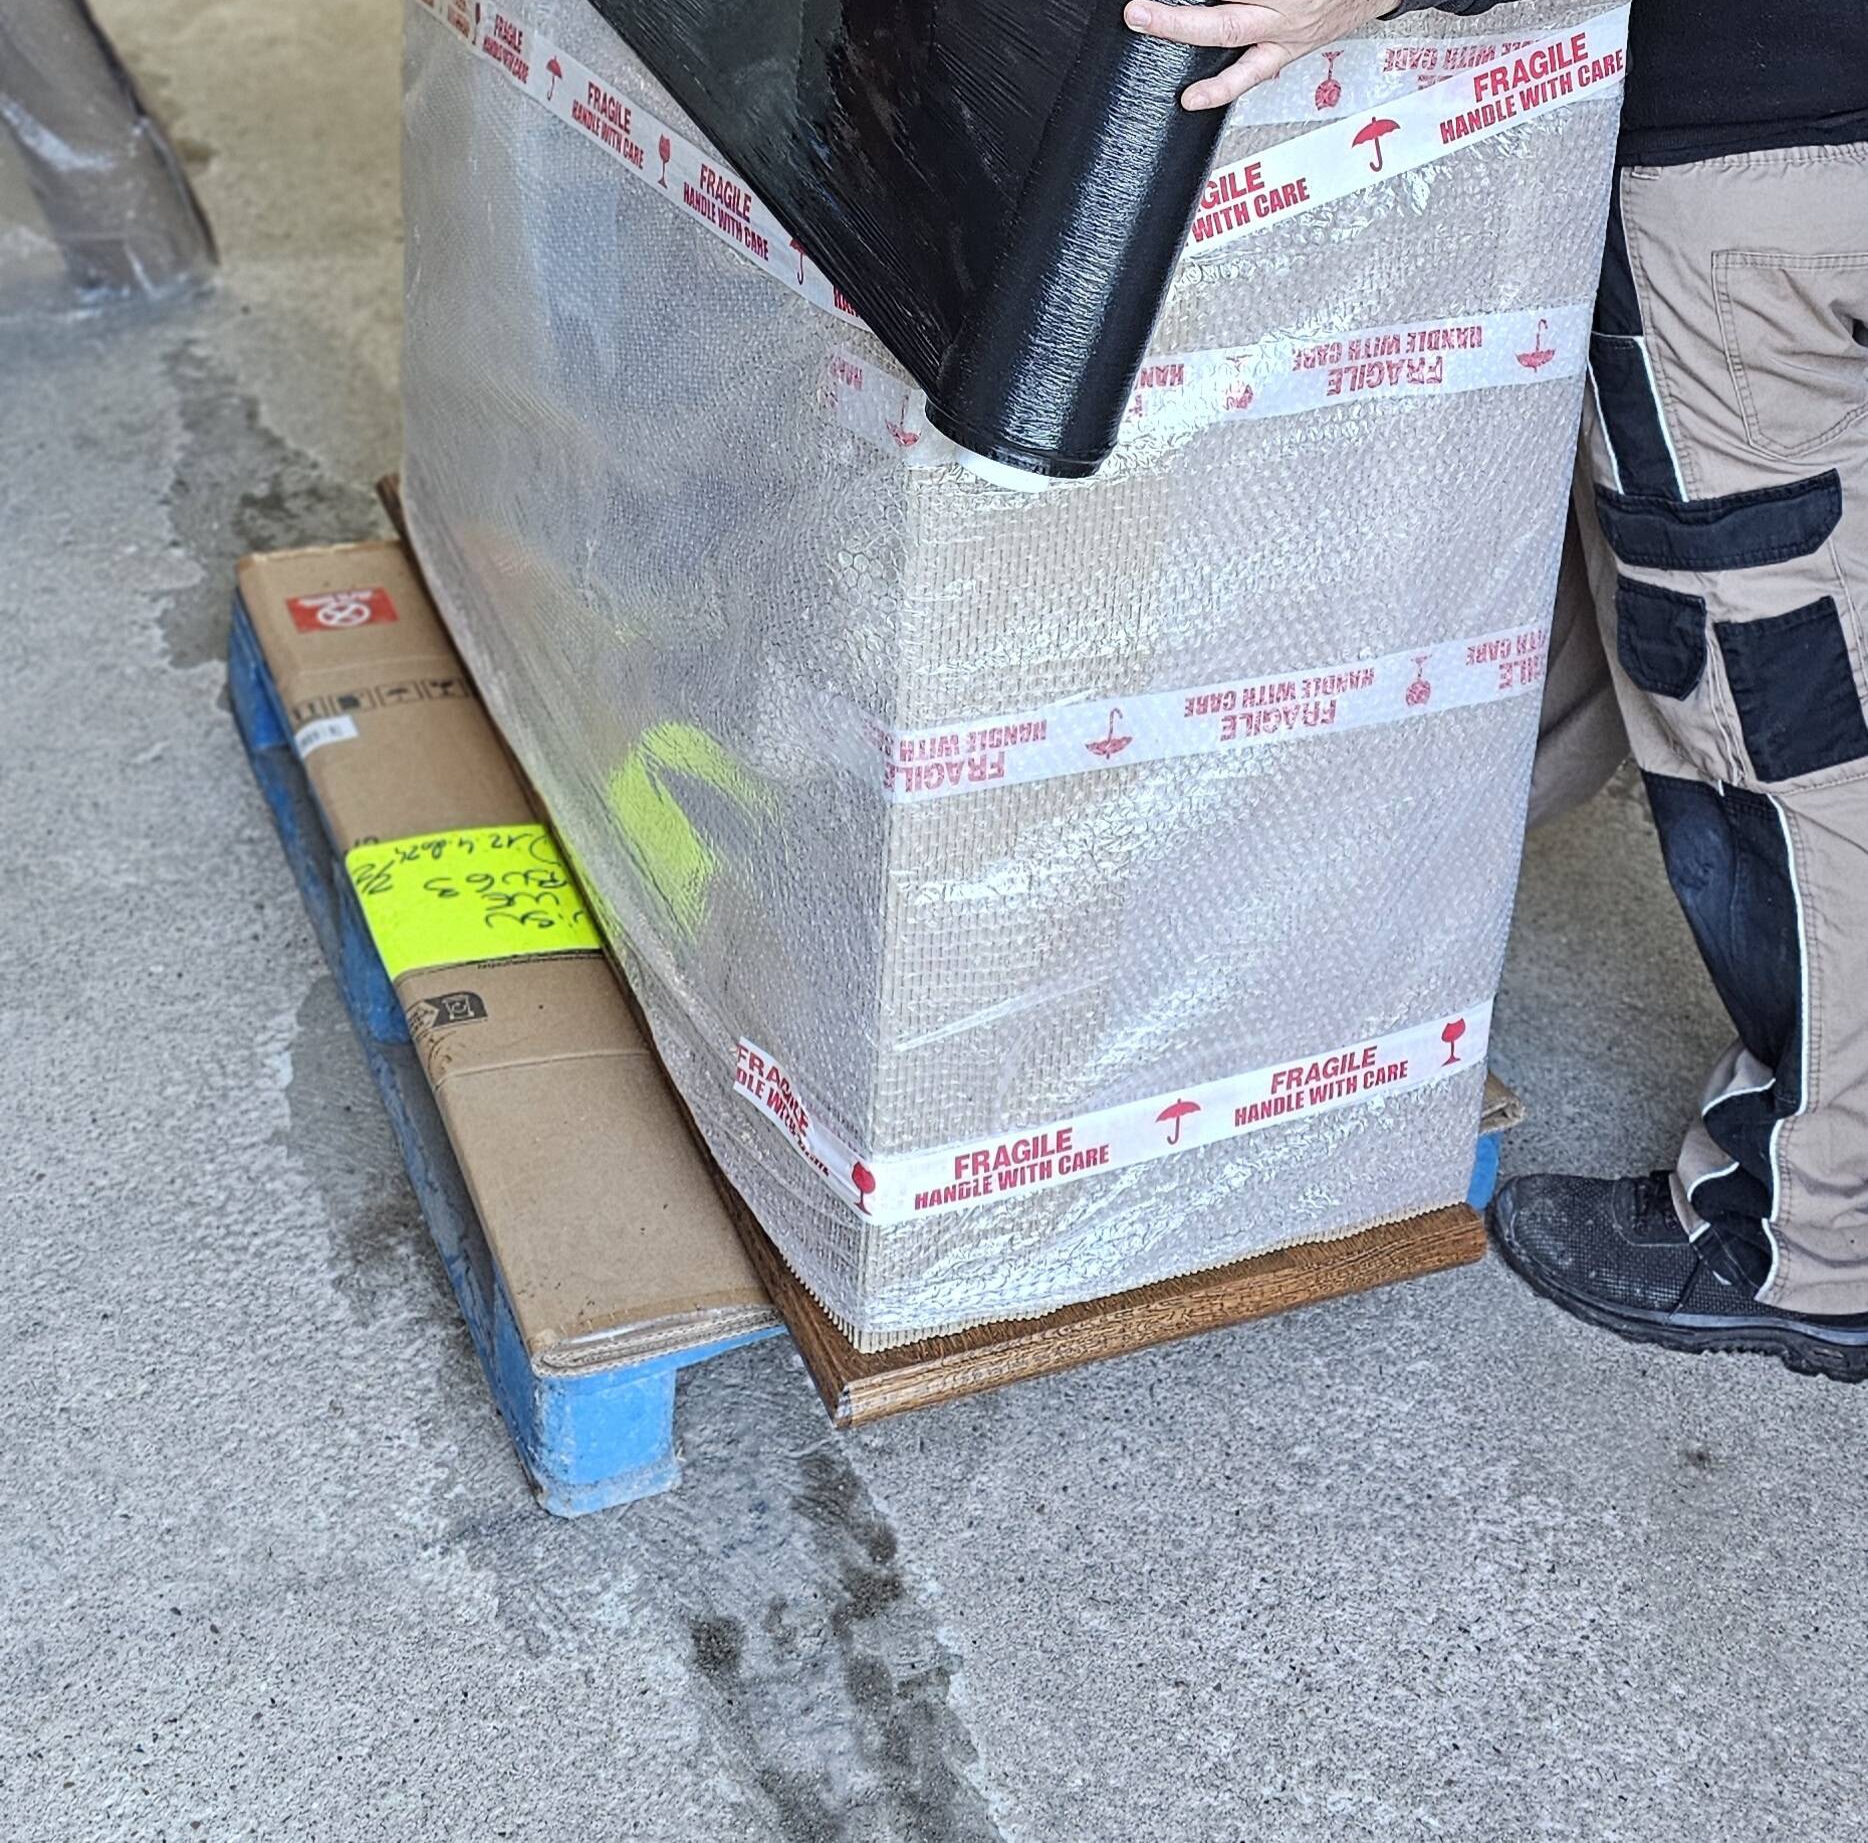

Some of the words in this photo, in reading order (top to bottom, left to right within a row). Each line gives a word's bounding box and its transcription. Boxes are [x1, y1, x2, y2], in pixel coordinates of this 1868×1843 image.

[1473, 32, 1588, 103] FRAGILE
[587, 81, 632, 135] FRAGILE
[1440, 94, 1517, 145] HANDLE
[1519, 71, 1574, 112] WITH
[1577, 48, 1624, 88] CARE
[571, 99, 601, 137] HANDLE
[601, 120, 622, 154] WITH
[623, 137, 644, 171] CARE
[700, 163, 752, 223] FRAGILE
[1200, 161, 1266, 210] GILE
[683, 181, 716, 225] HANDLE
[718, 206, 743, 243] WITH
[744, 226, 769, 262] CARE
[1191, 200, 1251, 243] WITH
[1253, 177, 1310, 218] CARE
[1292, 341, 1343, 371] CARE
[1348, 333, 1401, 362] WITH
[1405, 325, 1482, 354] HANDLE
[1134, 363, 1184, 389] HAN
[1326, 355, 1443, 397] FRAGILE
[1184, 690, 1237, 718] CARE
[1242, 680, 1297, 708] WITH
[1302, 667, 1375, 699] HANDLE
[966, 719, 1047, 754] HANDLE
[1220, 699, 1337, 742] FRAGILE
[900, 731, 960, 762] WITH
[883, 751, 1005, 793] FRAGILE
[736, 1066, 765, 1099] DLE
[1271, 1045, 1378, 1094] FRAGILE
[1234, 1090, 1305, 1127] HANDLE
[1309, 1074, 1358, 1106] WITH
[1363, 1060, 1409, 1090] CARE
[954, 1127, 1073, 1180] FRAGILE
[914, 1175, 993, 1211] HANDLE
[998, 1159, 1052, 1191] WITH
[1058, 1144, 1110, 1176] CARE
